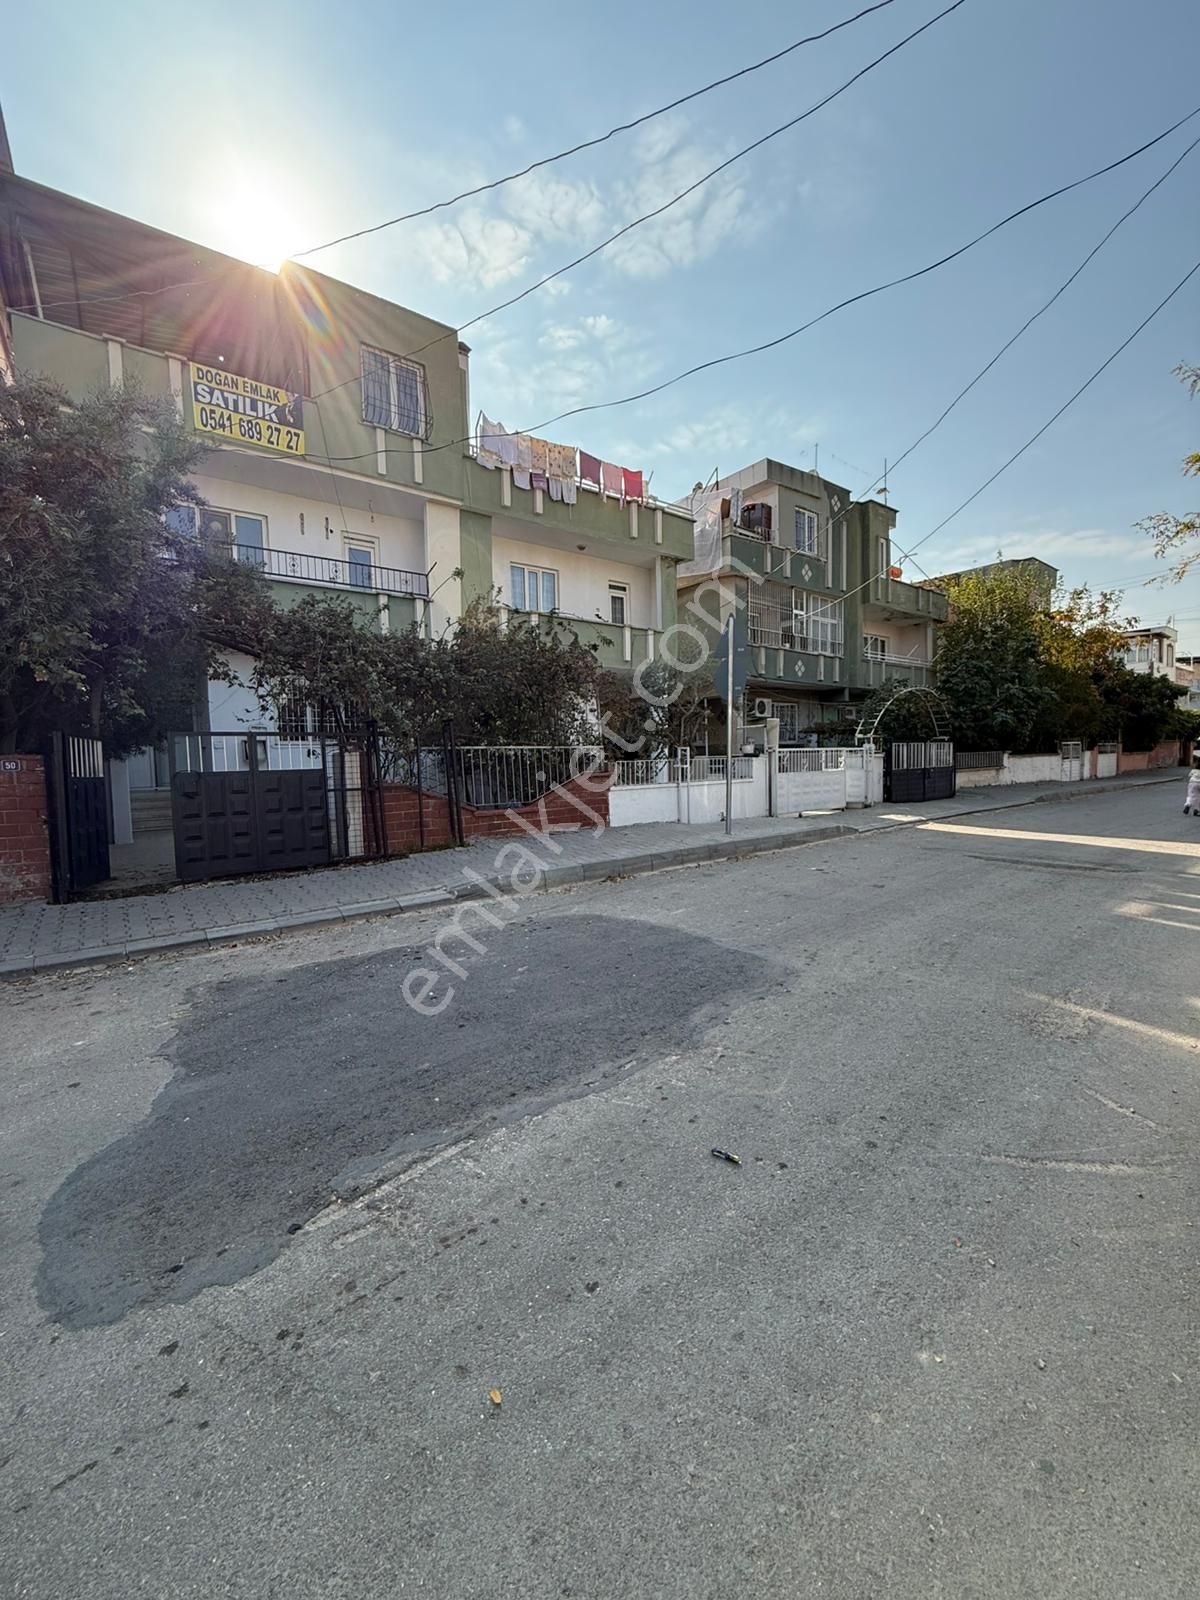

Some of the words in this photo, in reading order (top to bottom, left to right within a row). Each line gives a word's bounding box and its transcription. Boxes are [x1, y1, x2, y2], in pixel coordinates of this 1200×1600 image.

[196, 384, 279, 423] SATILIK
[242, 381, 281, 403] EMLAK
[200, 406, 233, 434] 0541
[238, 418, 262, 441] 689
[266, 424, 282, 447] 27
[285, 430, 301, 452] 27
[5, 761, 16, 770] 50
